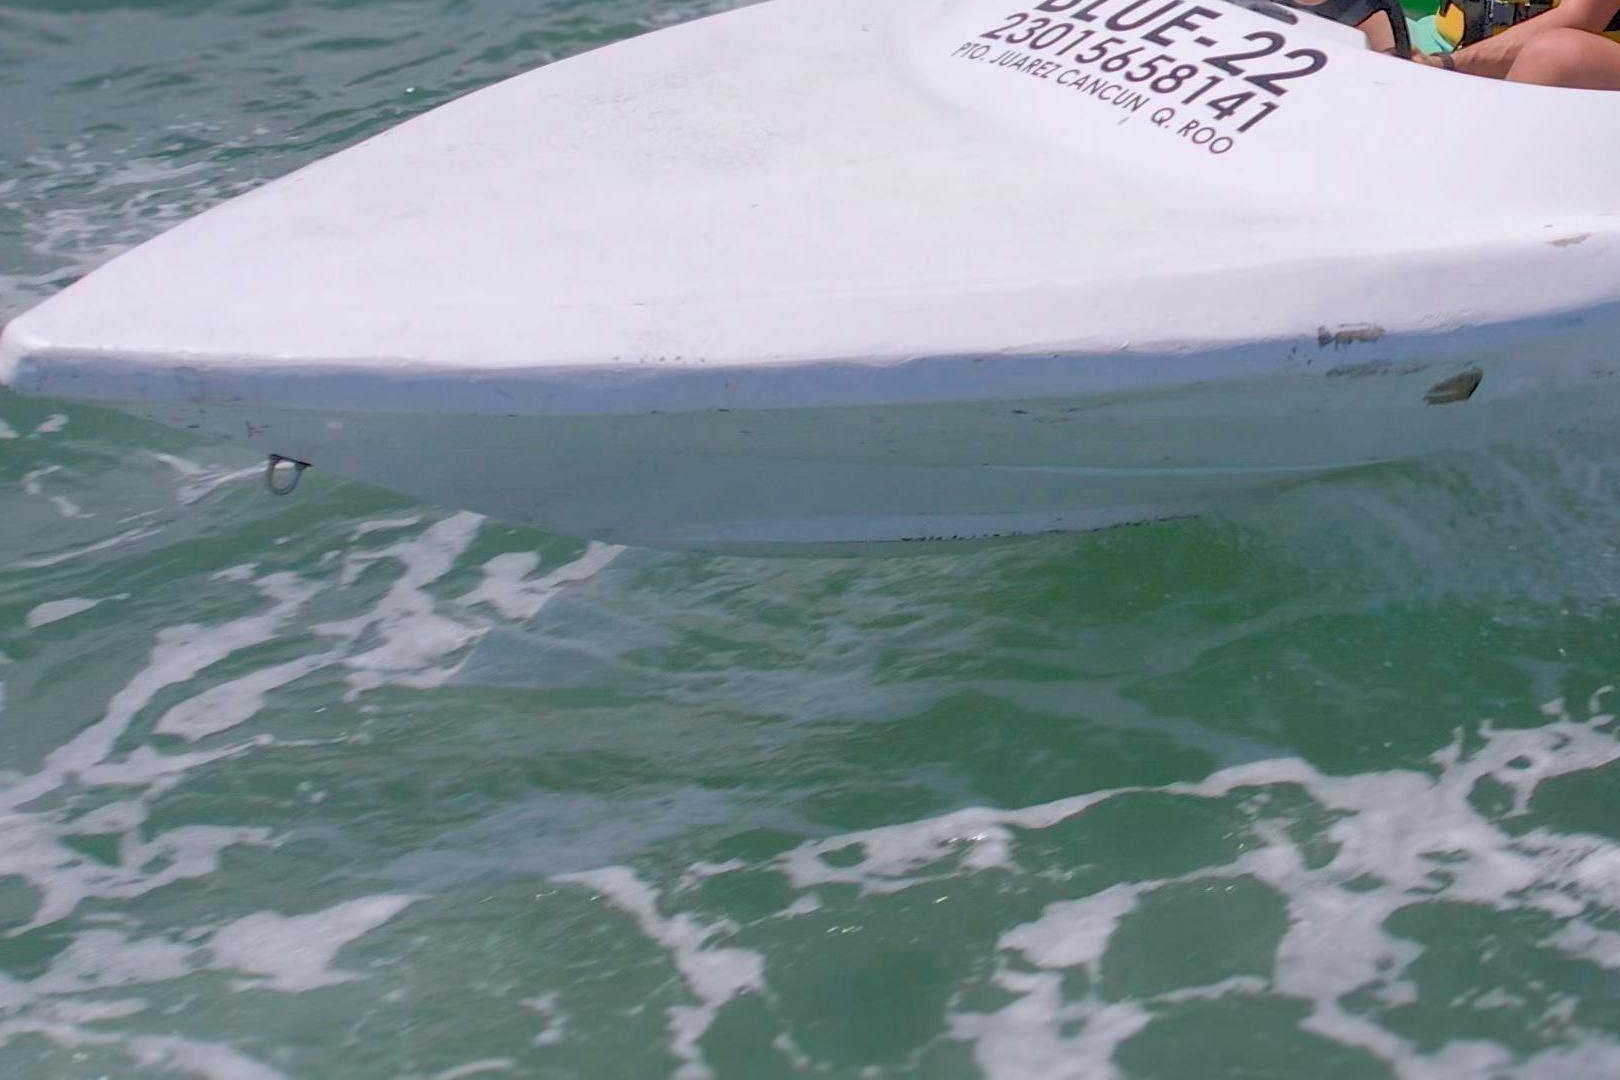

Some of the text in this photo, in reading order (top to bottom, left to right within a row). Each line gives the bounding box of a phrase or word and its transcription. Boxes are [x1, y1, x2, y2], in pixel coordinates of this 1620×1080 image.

[951, 42, 1233, 154] PTO. JUAREZ CANCUN Q. ROO
[979, 13, 1279, 134] 23015658141
